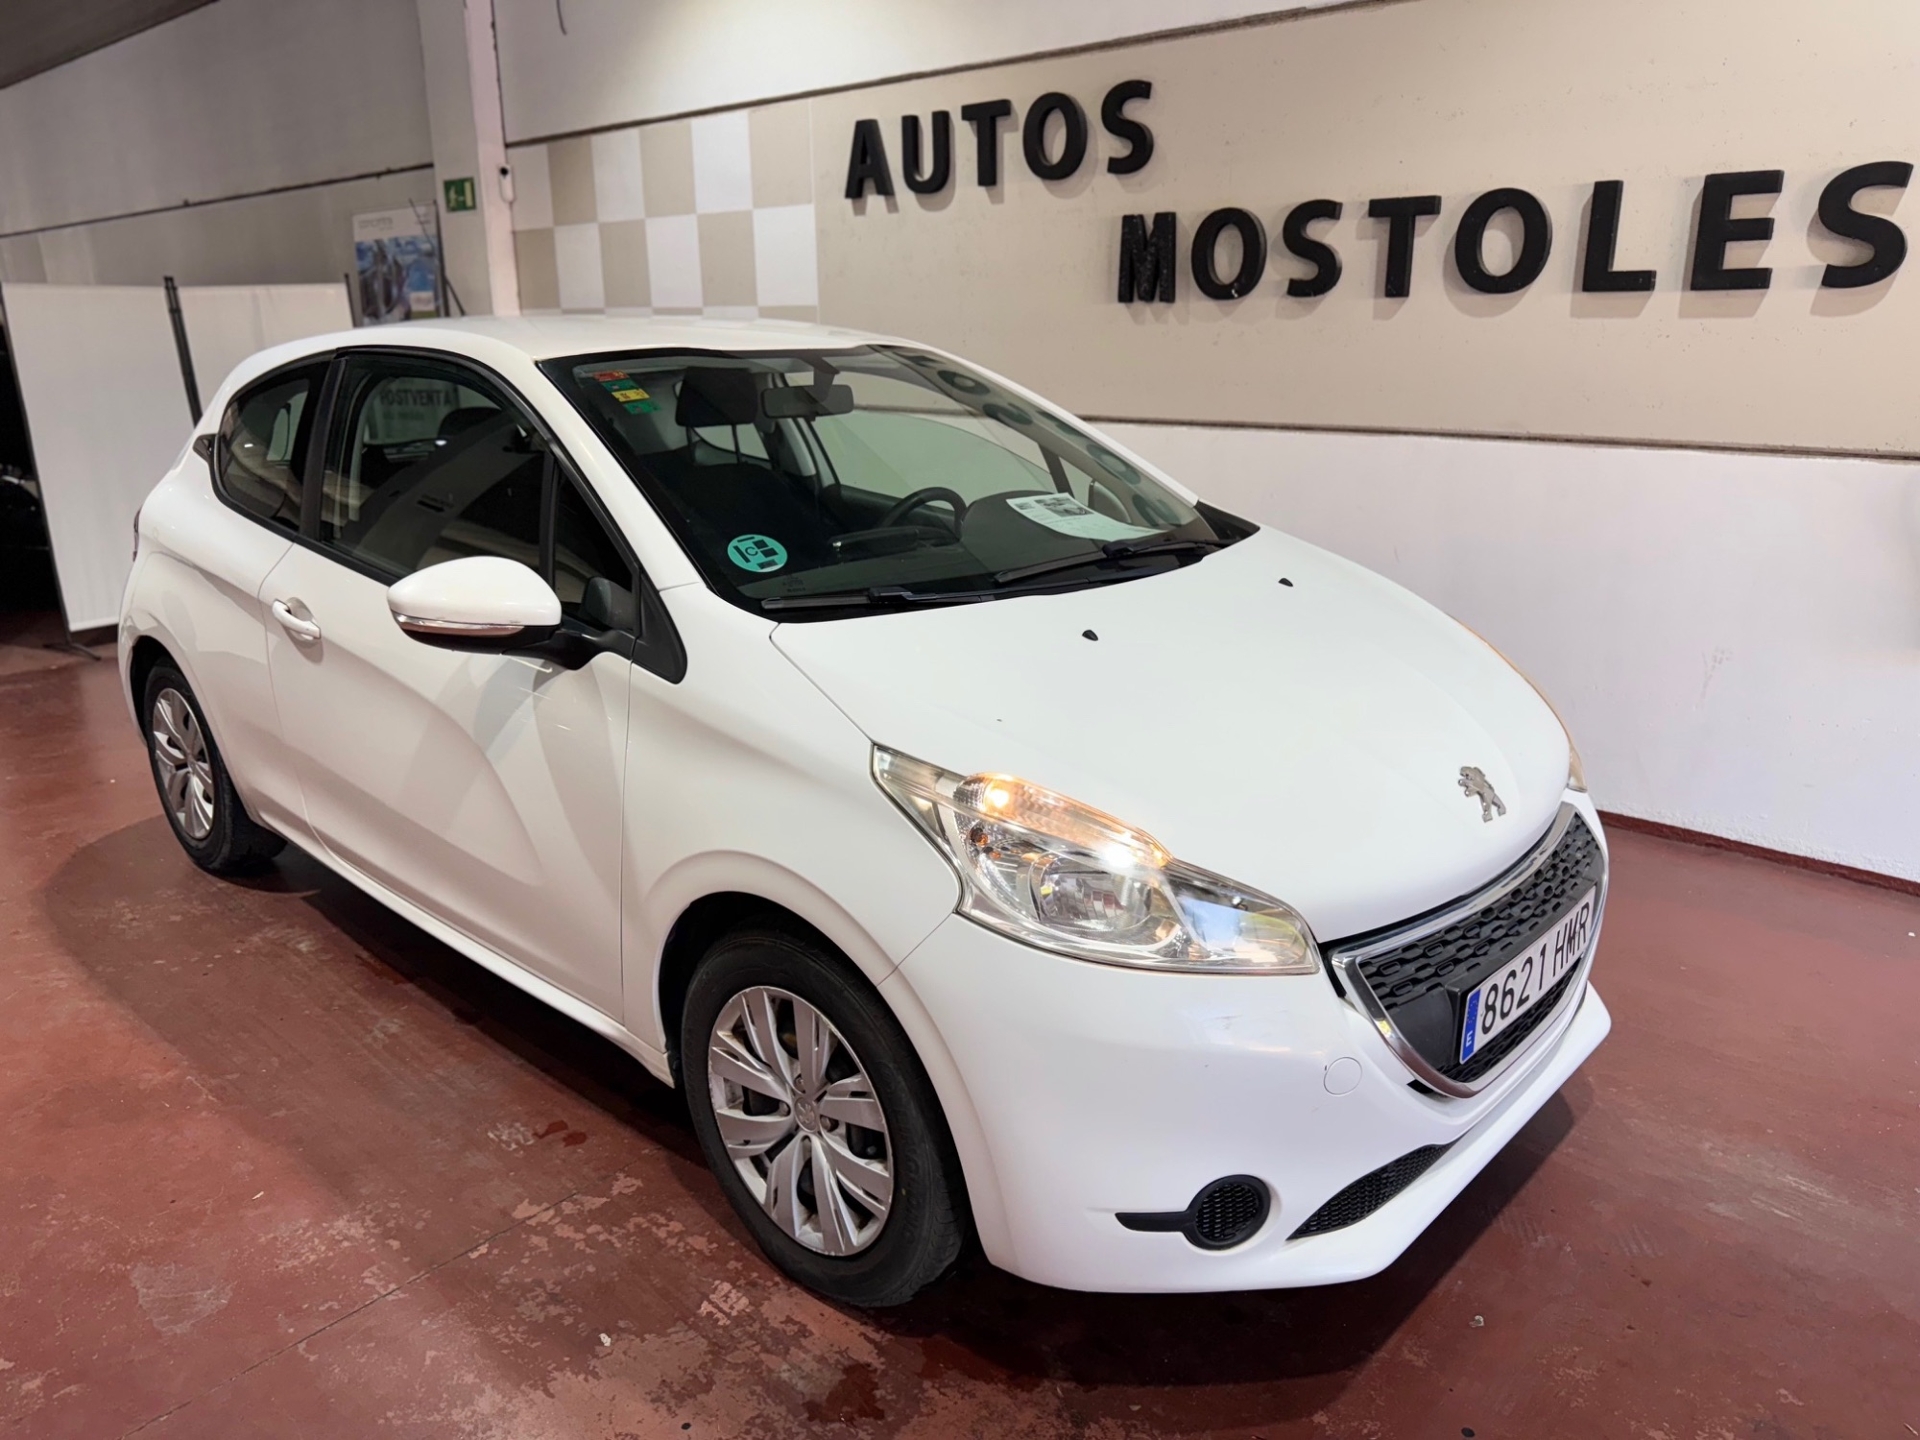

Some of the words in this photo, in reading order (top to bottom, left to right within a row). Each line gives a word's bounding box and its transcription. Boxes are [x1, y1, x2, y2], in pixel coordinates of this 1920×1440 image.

[844, 80, 1153, 199] AUTOS
[1117, 160, 1914, 304] MOSTOLES
[745, 546, 759, 557] C
[1465, 1030, 1473, 1047] E
[1481, 942, 1547, 1035] 8621
[1552, 902, 1590, 977] HMR
